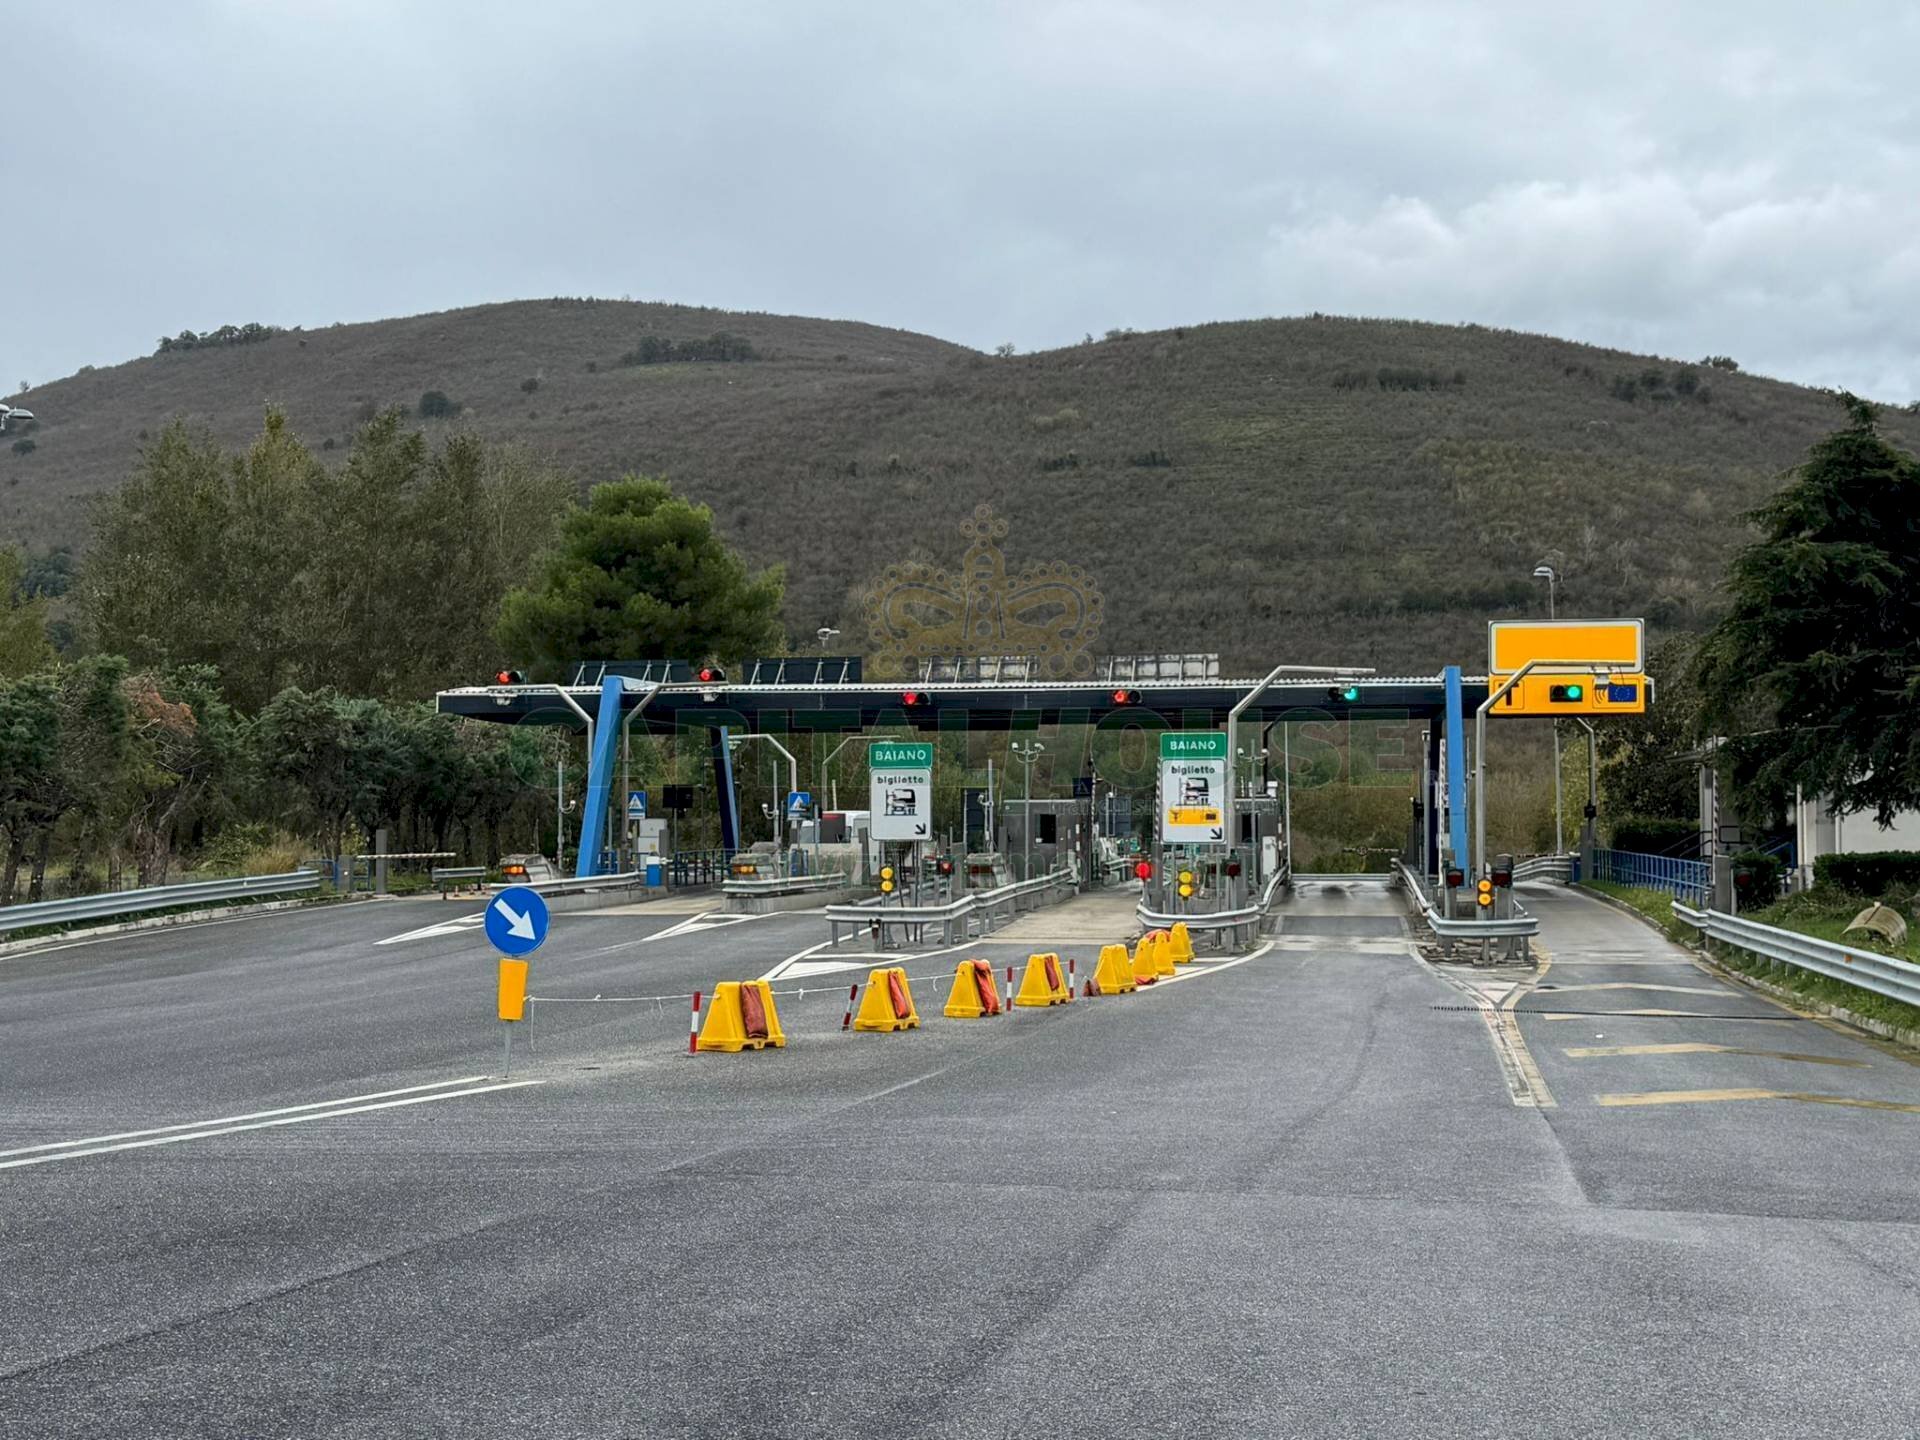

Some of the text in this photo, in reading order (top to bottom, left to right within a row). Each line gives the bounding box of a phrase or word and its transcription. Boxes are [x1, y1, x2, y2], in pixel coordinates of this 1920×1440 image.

[1169, 740, 1217, 751] BAIANO
[875, 749, 927, 761] BAIANO
[1171, 765, 1216, 776] biglietto
[876, 775, 925, 786] biglietto
